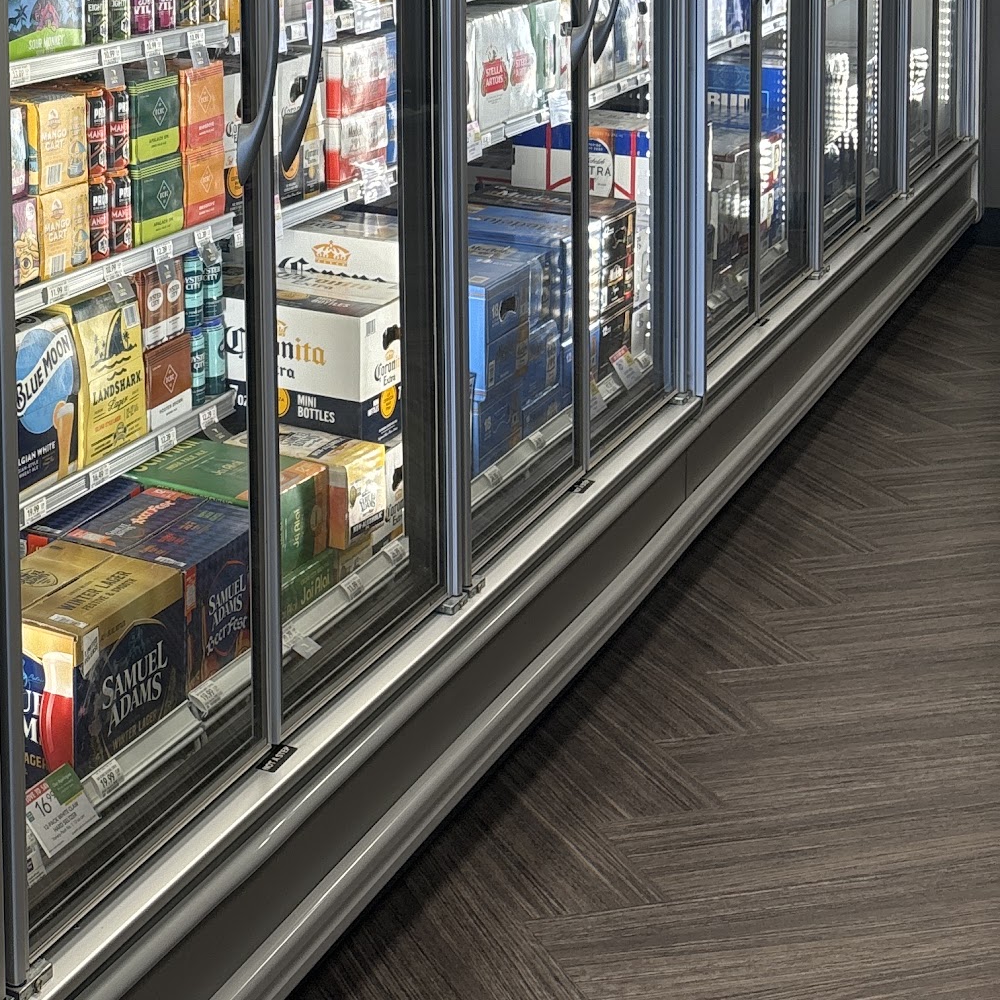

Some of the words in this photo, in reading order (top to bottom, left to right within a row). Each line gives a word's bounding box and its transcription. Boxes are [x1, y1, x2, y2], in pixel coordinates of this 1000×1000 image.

[485, 65, 503, 76] STELLA
[485, 73, 505, 86] ARTOIS
[41, 129, 67, 143] MANGO
[44, 139, 65, 151] CART
[44, 218, 71, 233] MANGO
[47, 228, 68, 241] CART
[16, 373, 44, 415] BLUE
[42, 334, 70, 372] MOON
[92, 370, 142, 406] LANDSHARK
[297, 394, 317, 408] MINI
[297, 406, 335, 424] BOTTLES
[37, 441, 56, 457] WHITE
[208, 574, 247, 616] SAMUEL
[211, 594, 243, 631] ADAMS
[102, 640, 169, 710] SAMUEL
[106, 671, 164, 737] ADAMS
